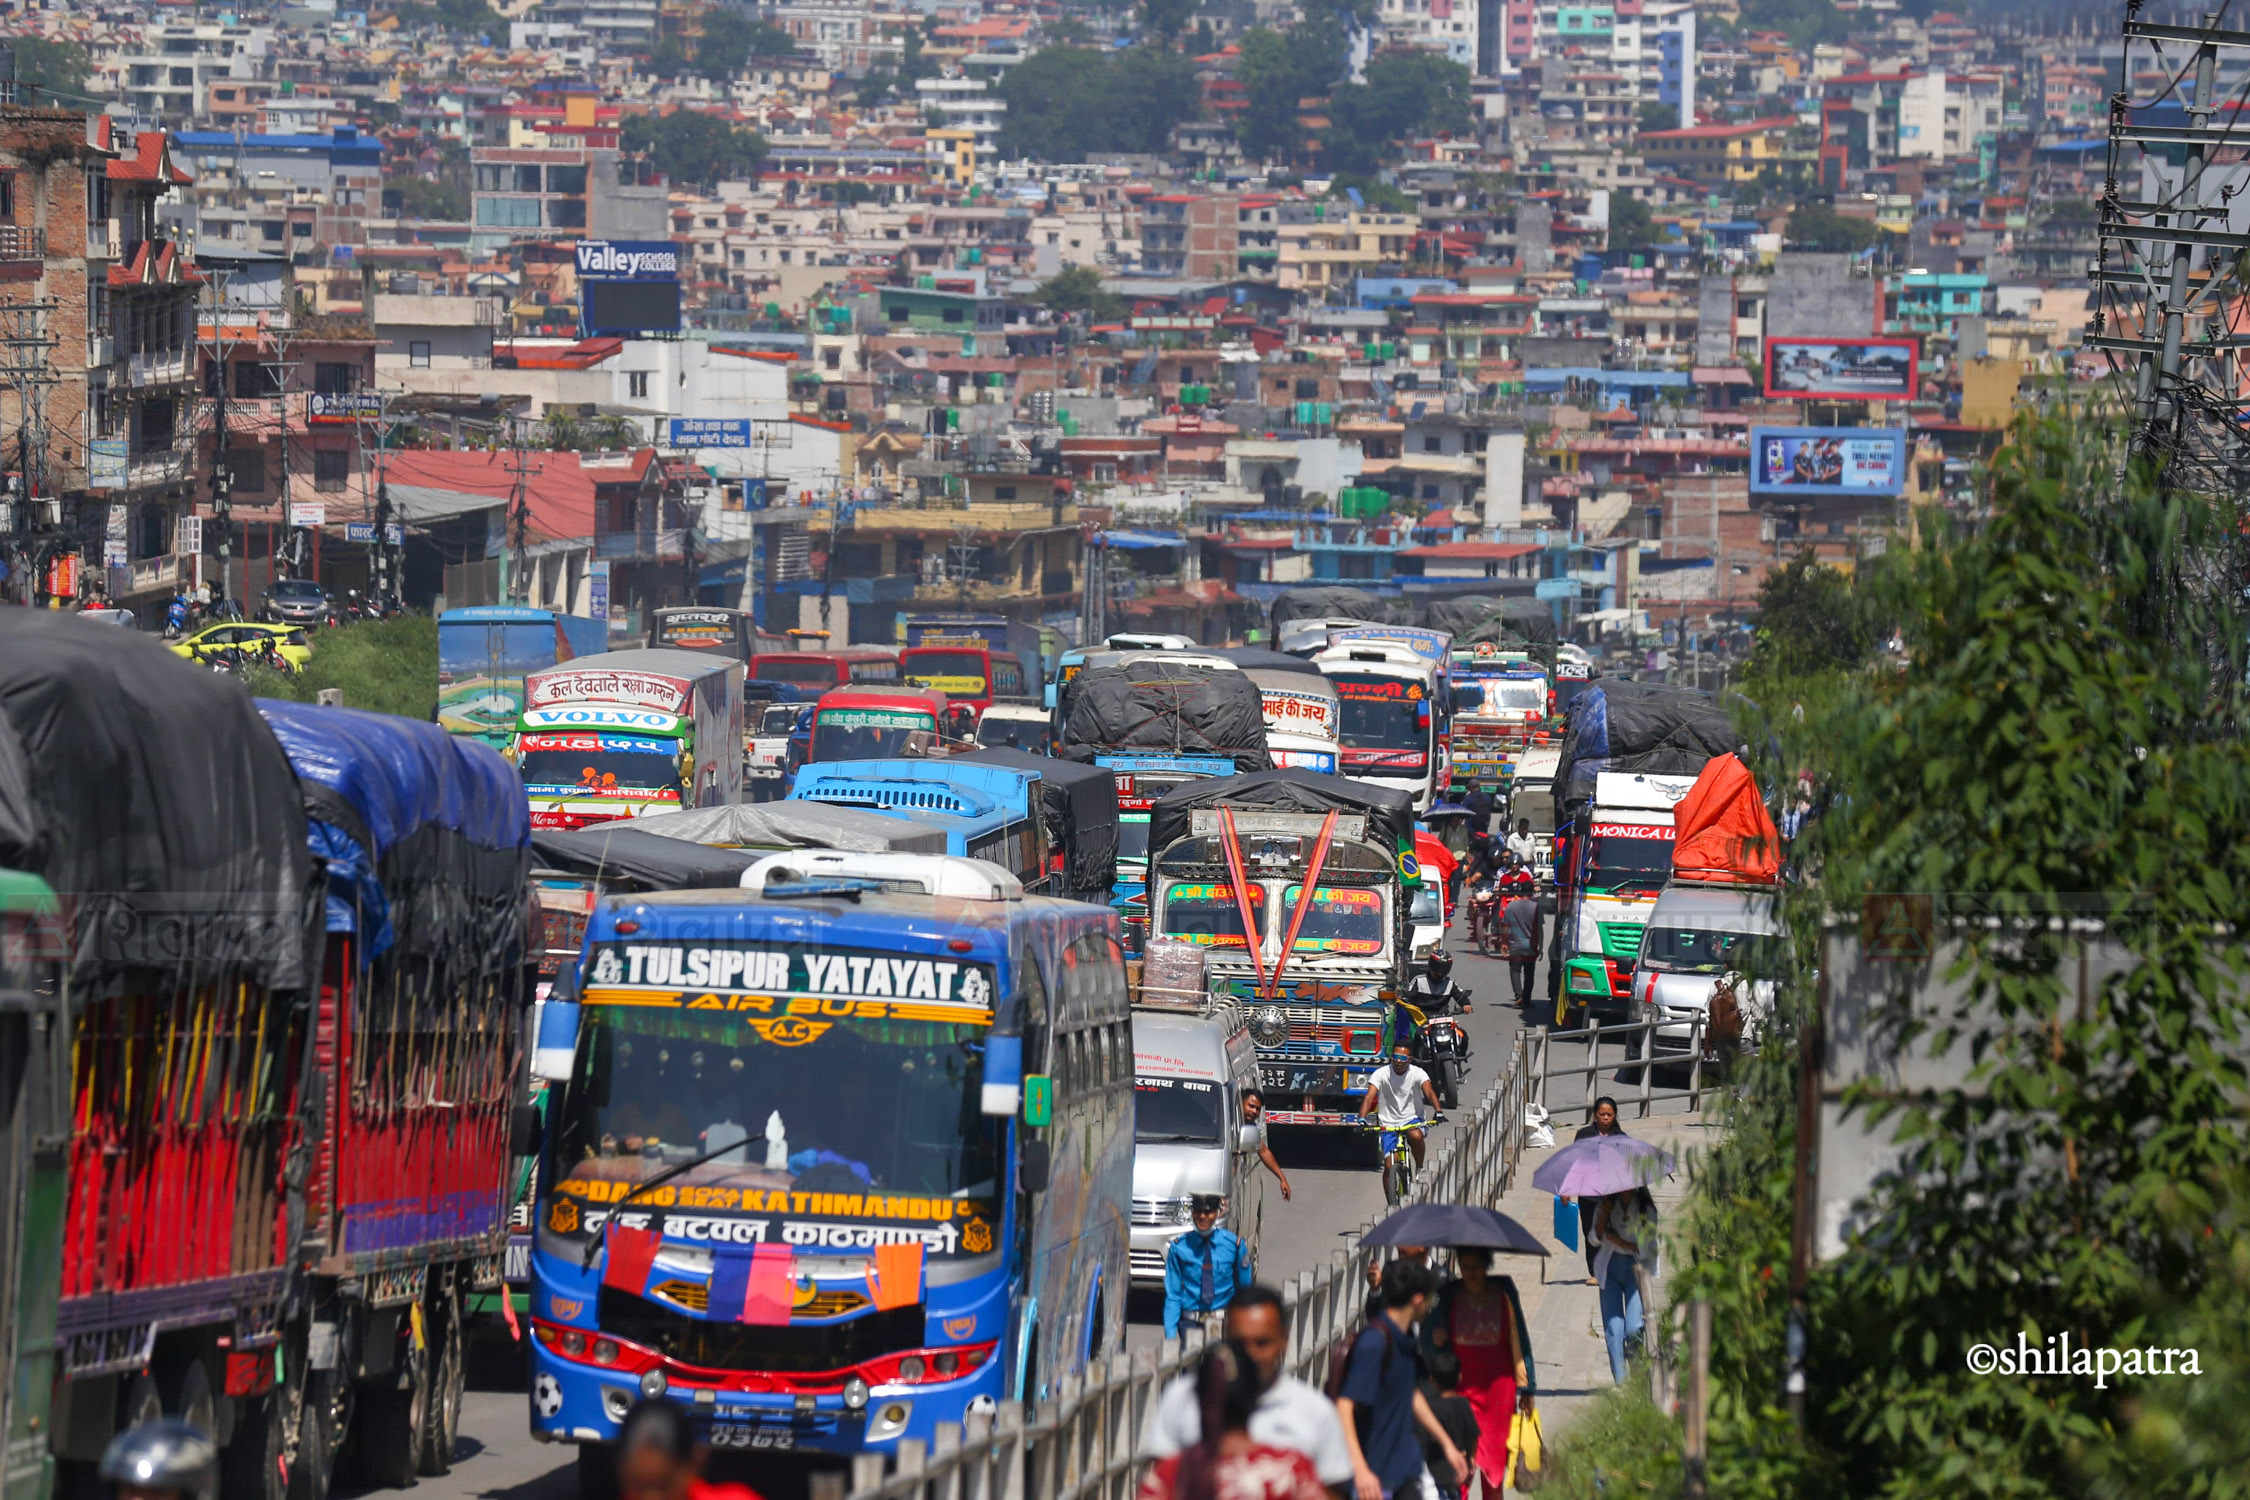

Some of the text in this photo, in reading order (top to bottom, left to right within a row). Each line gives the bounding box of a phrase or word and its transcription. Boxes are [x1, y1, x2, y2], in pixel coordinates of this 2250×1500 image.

[578, 247, 677, 275] Valley SCHOOL
[640, 262, 677, 271] COLLEGE
[535, 711, 668, 726] VOLVO
[1286, 699, 1300, 718] की
[1302, 704, 1326, 721] जय
[1591, 826, 1659, 838] MONICA
[1347, 893, 1371, 903] जय
[626, 946, 958, 1001] TULSIPUR YATAYAT
[686, 993, 888, 1019] AIR BUS
[1183, 1081, 1212, 1092] बाबा
[741, 1189, 953, 1221] KATHMANDU
